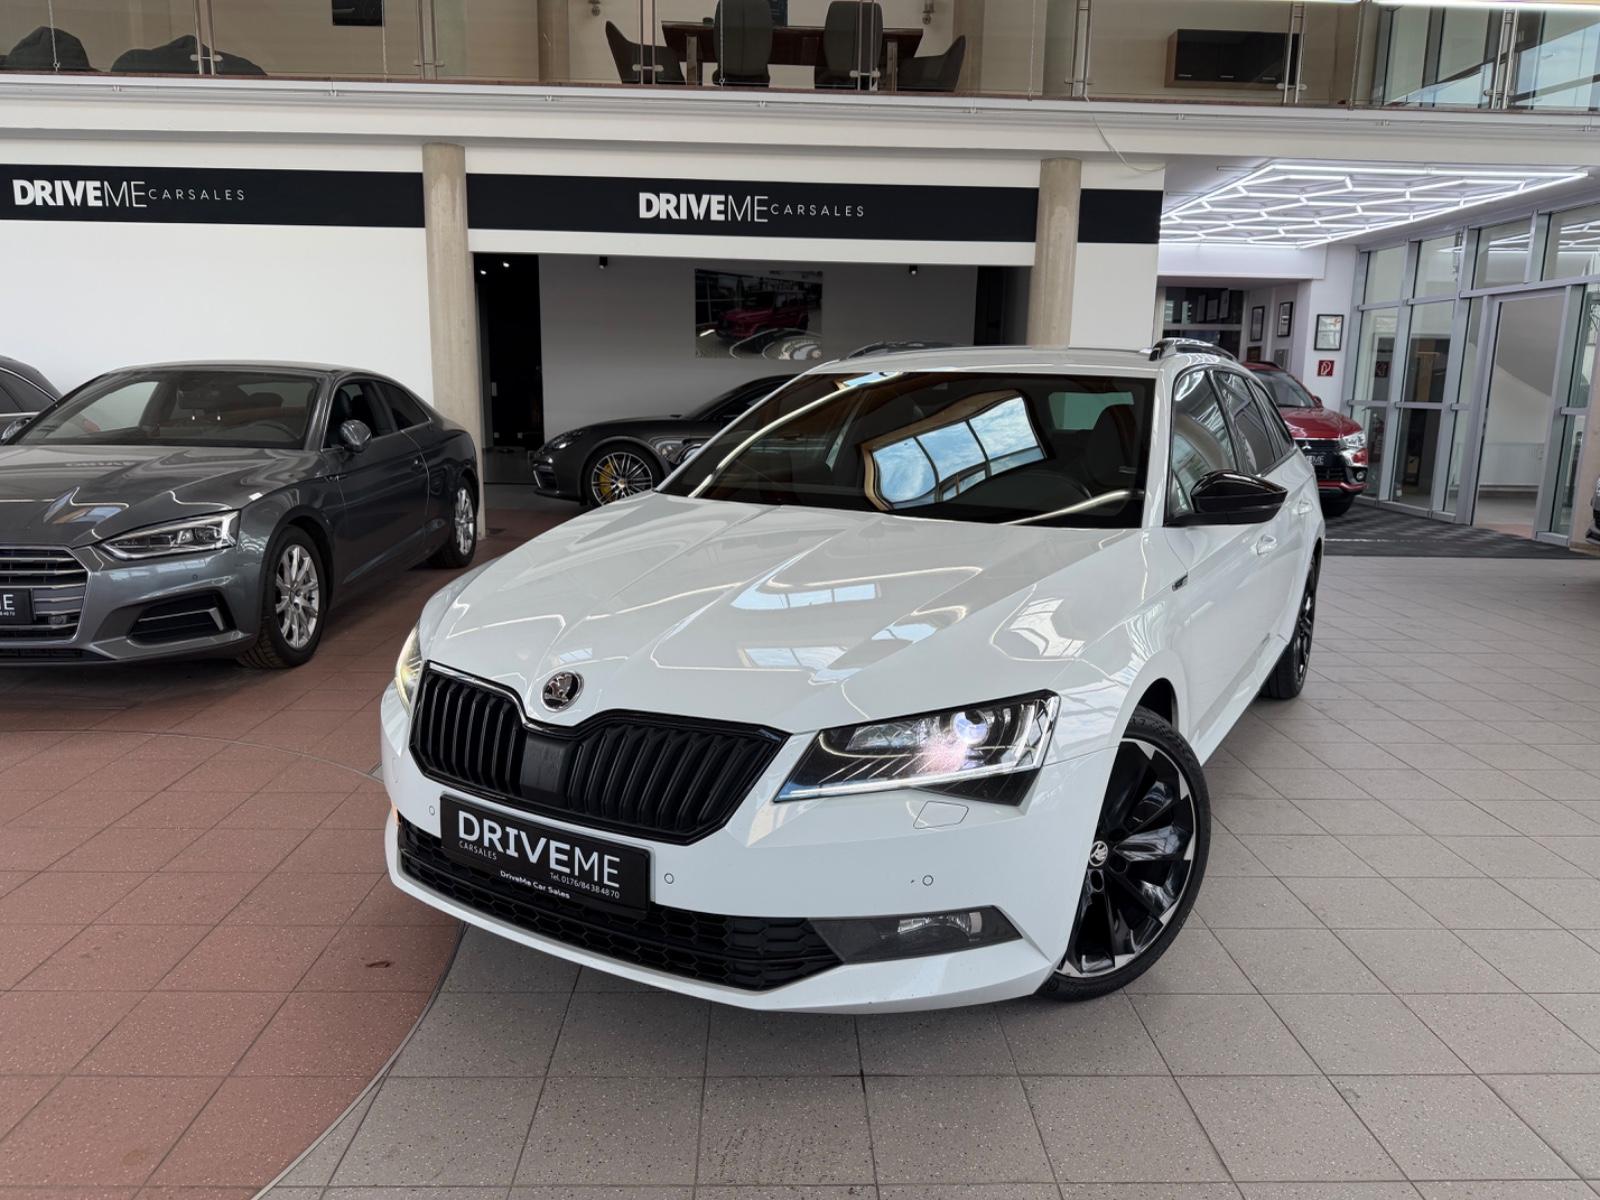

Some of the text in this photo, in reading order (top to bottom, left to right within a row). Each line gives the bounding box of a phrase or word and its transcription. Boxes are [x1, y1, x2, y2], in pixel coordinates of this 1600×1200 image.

[12, 179, 245, 208] DRIVEME CARSALES
[638, 192, 865, 222] DRIVEME CARSALES
[458, 811, 620, 888] DRIVEME
[458, 840, 497, 860] CARSALES
[533, 881, 547, 891] Car
[547, 886, 571, 899] Sales
